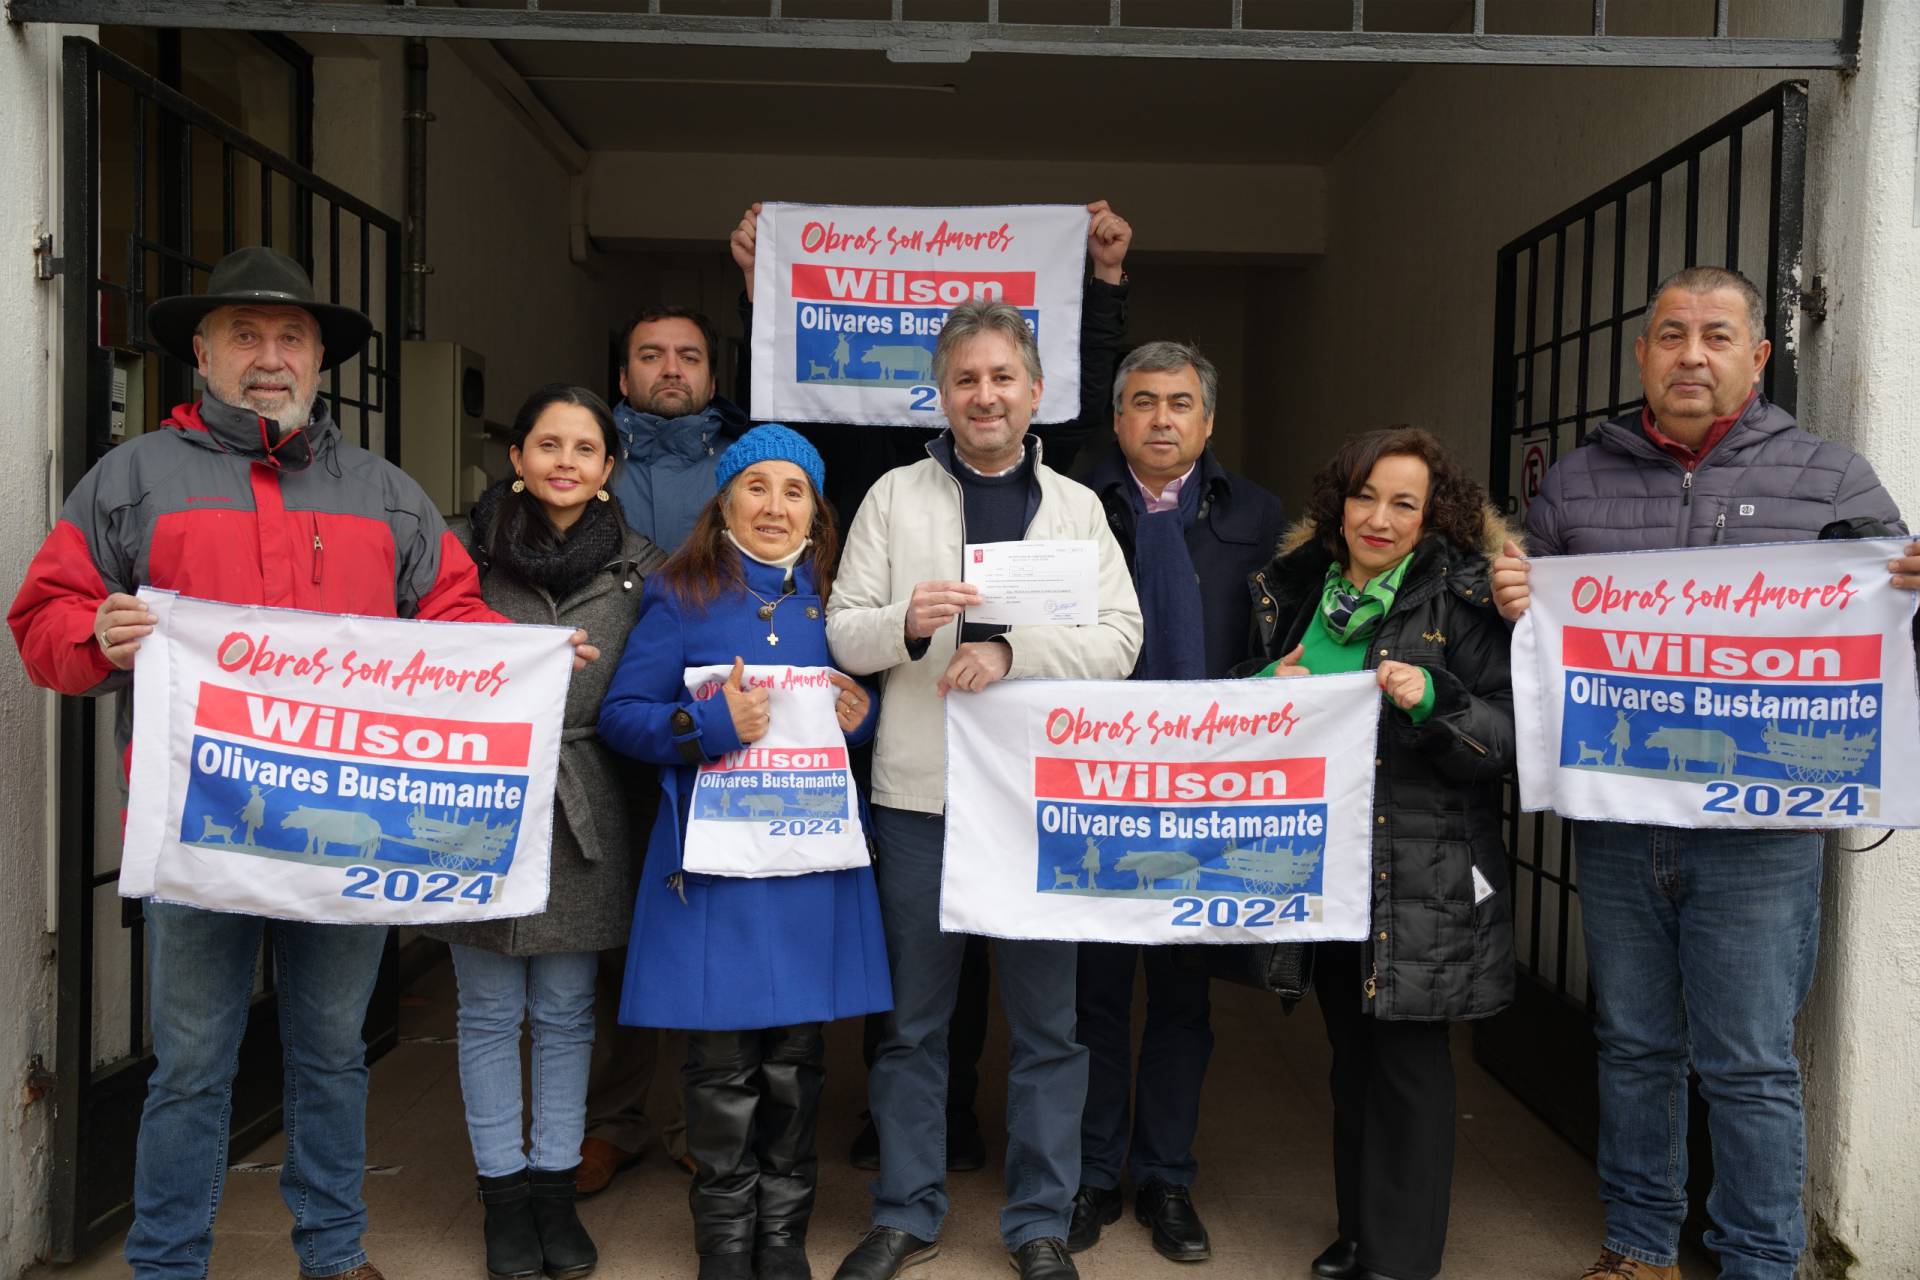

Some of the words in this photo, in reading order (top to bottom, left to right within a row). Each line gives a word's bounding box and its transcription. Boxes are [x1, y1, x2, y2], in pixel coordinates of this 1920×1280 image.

[801, 221, 882, 254] Obras
[886, 226, 923, 255] son
[926, 220, 1014, 256] Amores
[824, 268, 1003, 303] Wilson
[801, 305, 893, 335] Olivares
[1571, 575, 1675, 614] Obras
[1682, 579, 1728, 615] son
[1733, 570, 1858, 617] Amores
[217, 631, 333, 677] Obras
[341, 650, 387, 687] son
[391, 649, 509, 696] Amores
[1602, 632, 1840, 677] Wilson
[781, 667, 829, 690] Amores
[1570, 676, 1685, 714] Olivares
[1694, 686, 1877, 721] Bustamante
[246, 695, 488, 762] Wilson
[1046, 707, 1141, 745] Obras
[1147, 710, 1188, 742] son
[1192, 701, 1300, 745] Amores
[197, 742, 328, 795] Olivares
[338, 766, 521, 810] Bustamante
[725, 749, 829, 769] Wilson
[700, 773, 758, 789] Olivares
[762, 772, 846, 789] Bustamante
[1074, 761, 1287, 800] Wilson
[1702, 782, 1864, 817] 2024
[769, 819, 842, 836] 2024
[1042, 805, 1151, 838] Olivares
[1160, 809, 1323, 839] Bustamante
[341, 866, 494, 904] 2024
[1171, 895, 1310, 928] 2024
